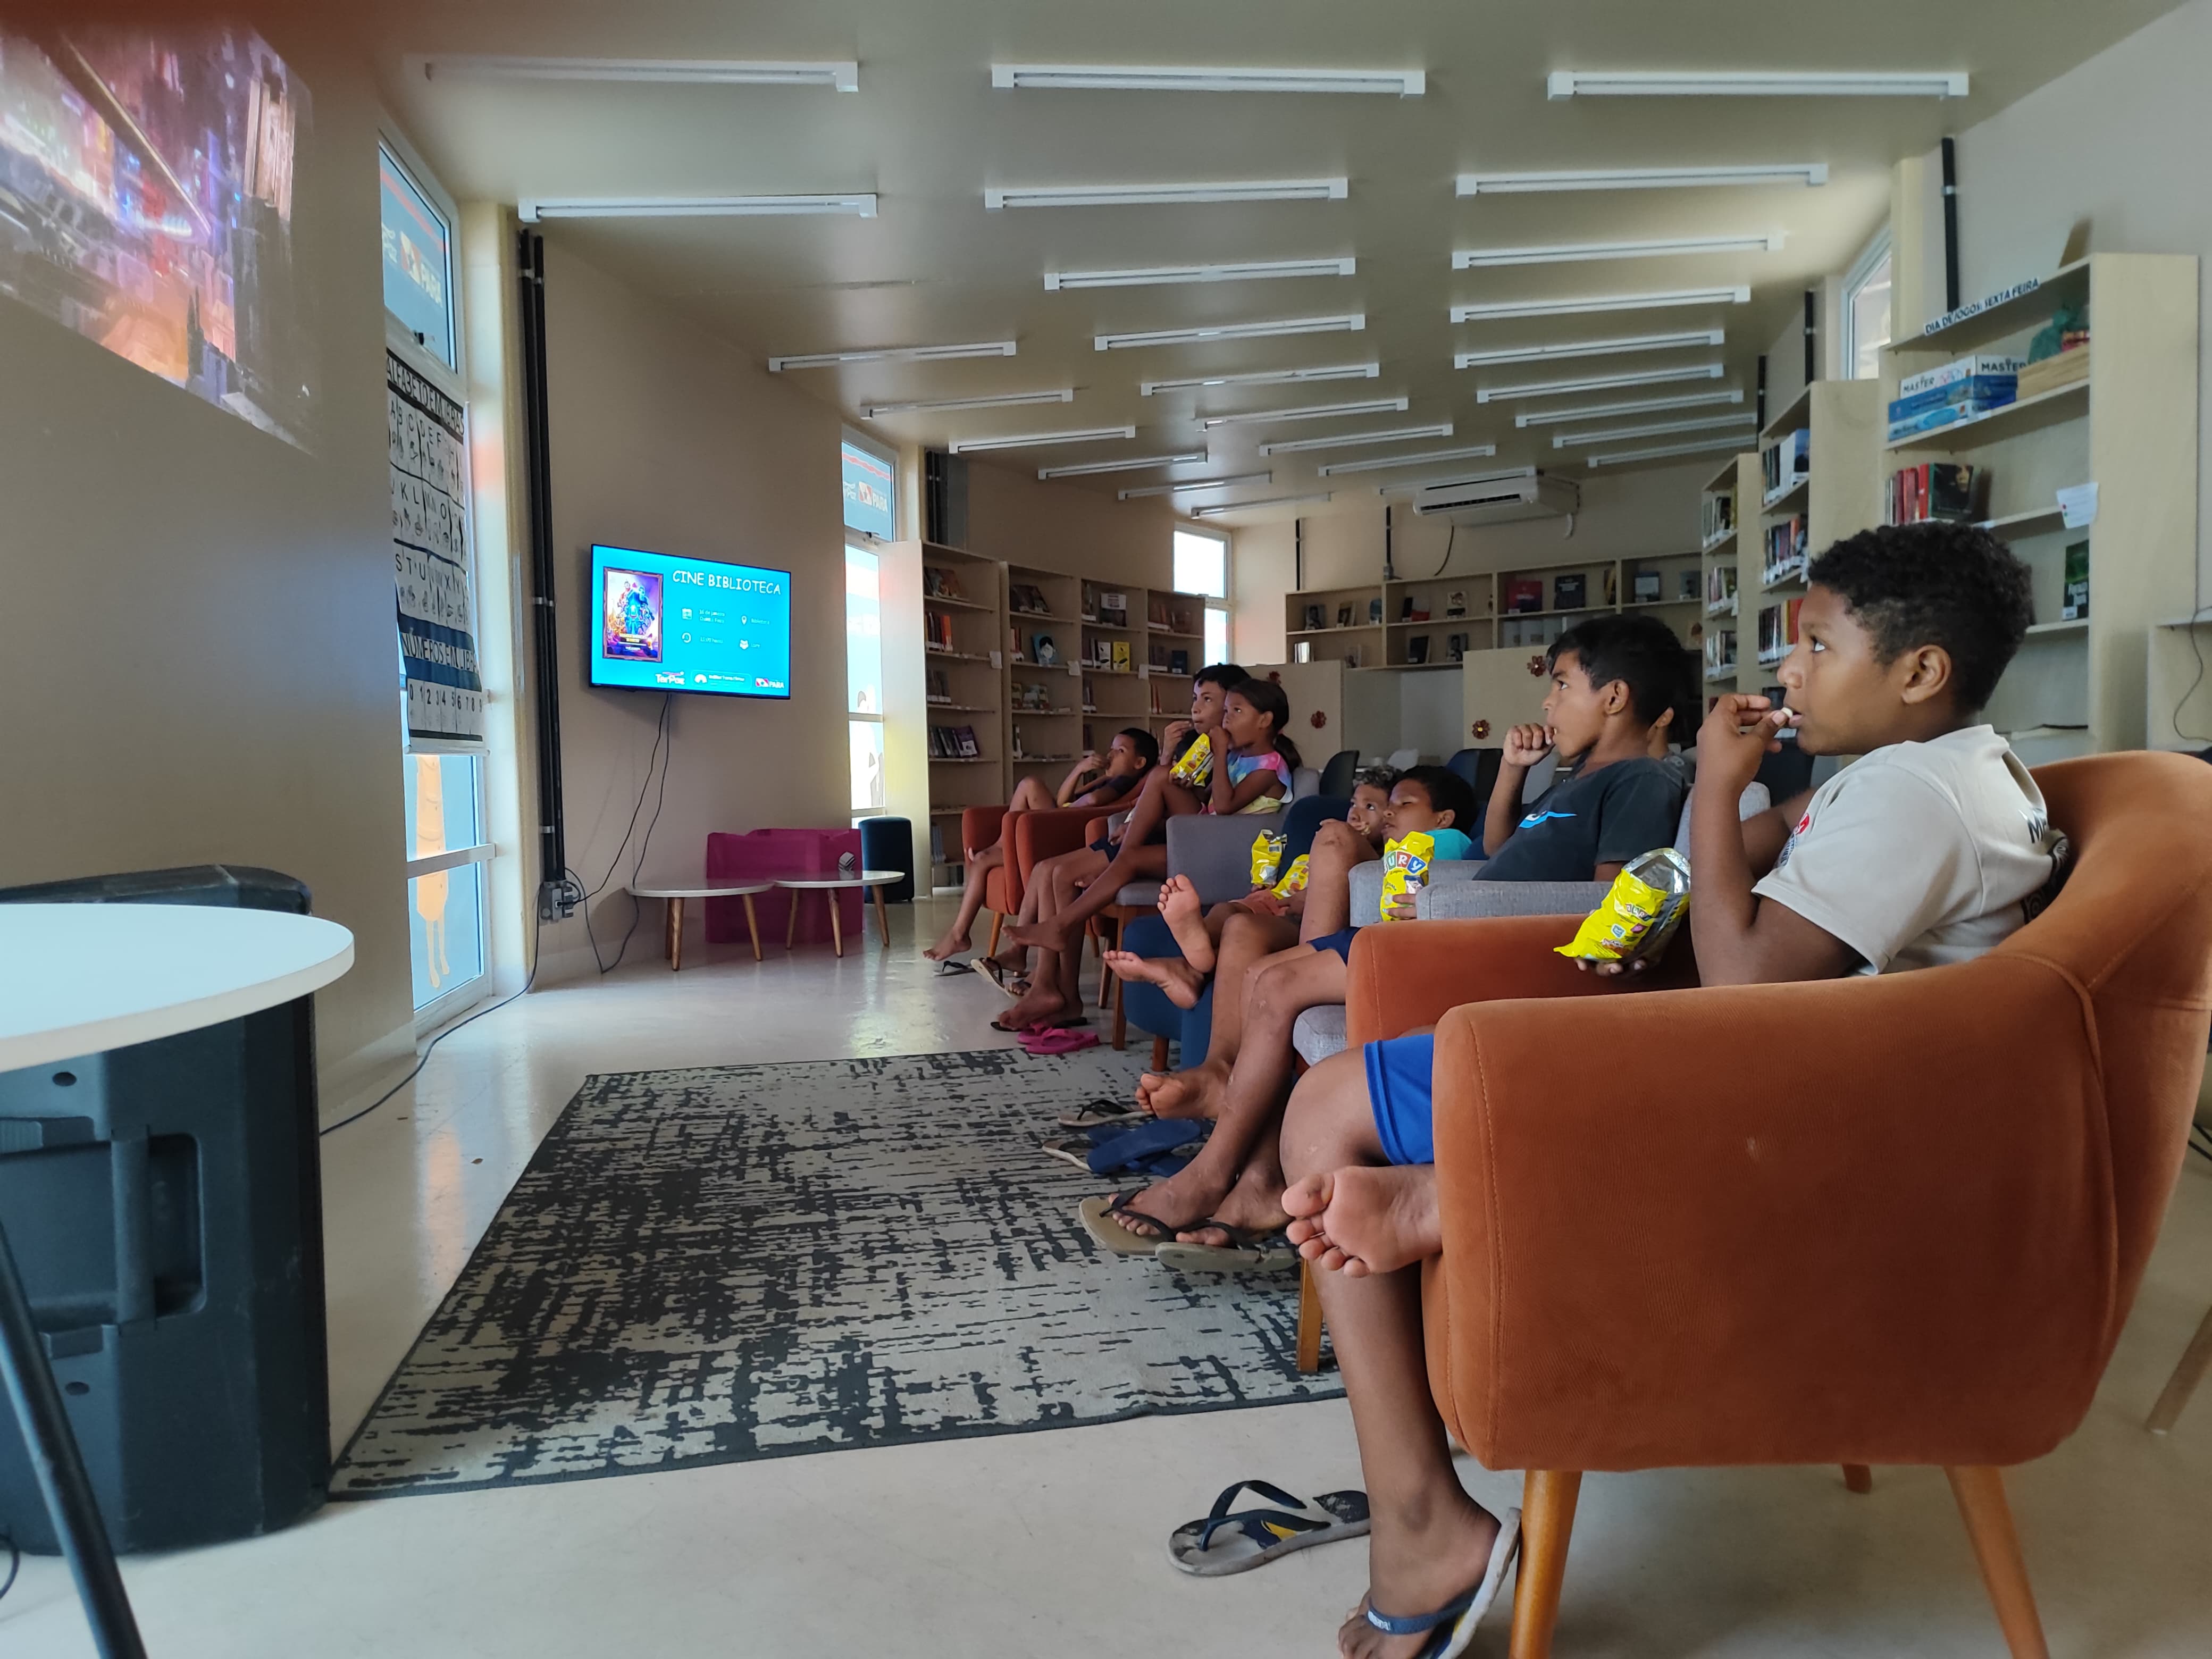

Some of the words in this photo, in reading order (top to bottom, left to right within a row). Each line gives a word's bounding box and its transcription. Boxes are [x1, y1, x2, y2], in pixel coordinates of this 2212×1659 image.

[1925, 320, 1940, 334] DIA
[1942, 312, 1953, 326] DE
[1984, 289, 2010, 308] SEXTA
[2012, 278, 2039, 297] FEIRA
[387, 356, 428, 408] ALFABETO
[430, 389, 442, 418] EM
[444, 402, 464, 435] BRAS
[1903, 376, 1935, 392] MASTER
[401, 482, 408, 501] K
[413, 486, 419, 505] L
[395, 554, 402, 572] S
[406, 557, 411, 575] T
[419, 563, 425, 581] U
[672, 570, 705, 585] CINE
[708, 574, 781, 595] BIBLIOTECA
[409, 684, 414, 701] 0
[426, 689, 431, 705] 2
[442, 690, 446, 706] 4
[457, 695, 462, 710] 6
[471, 698, 475, 711] 8
